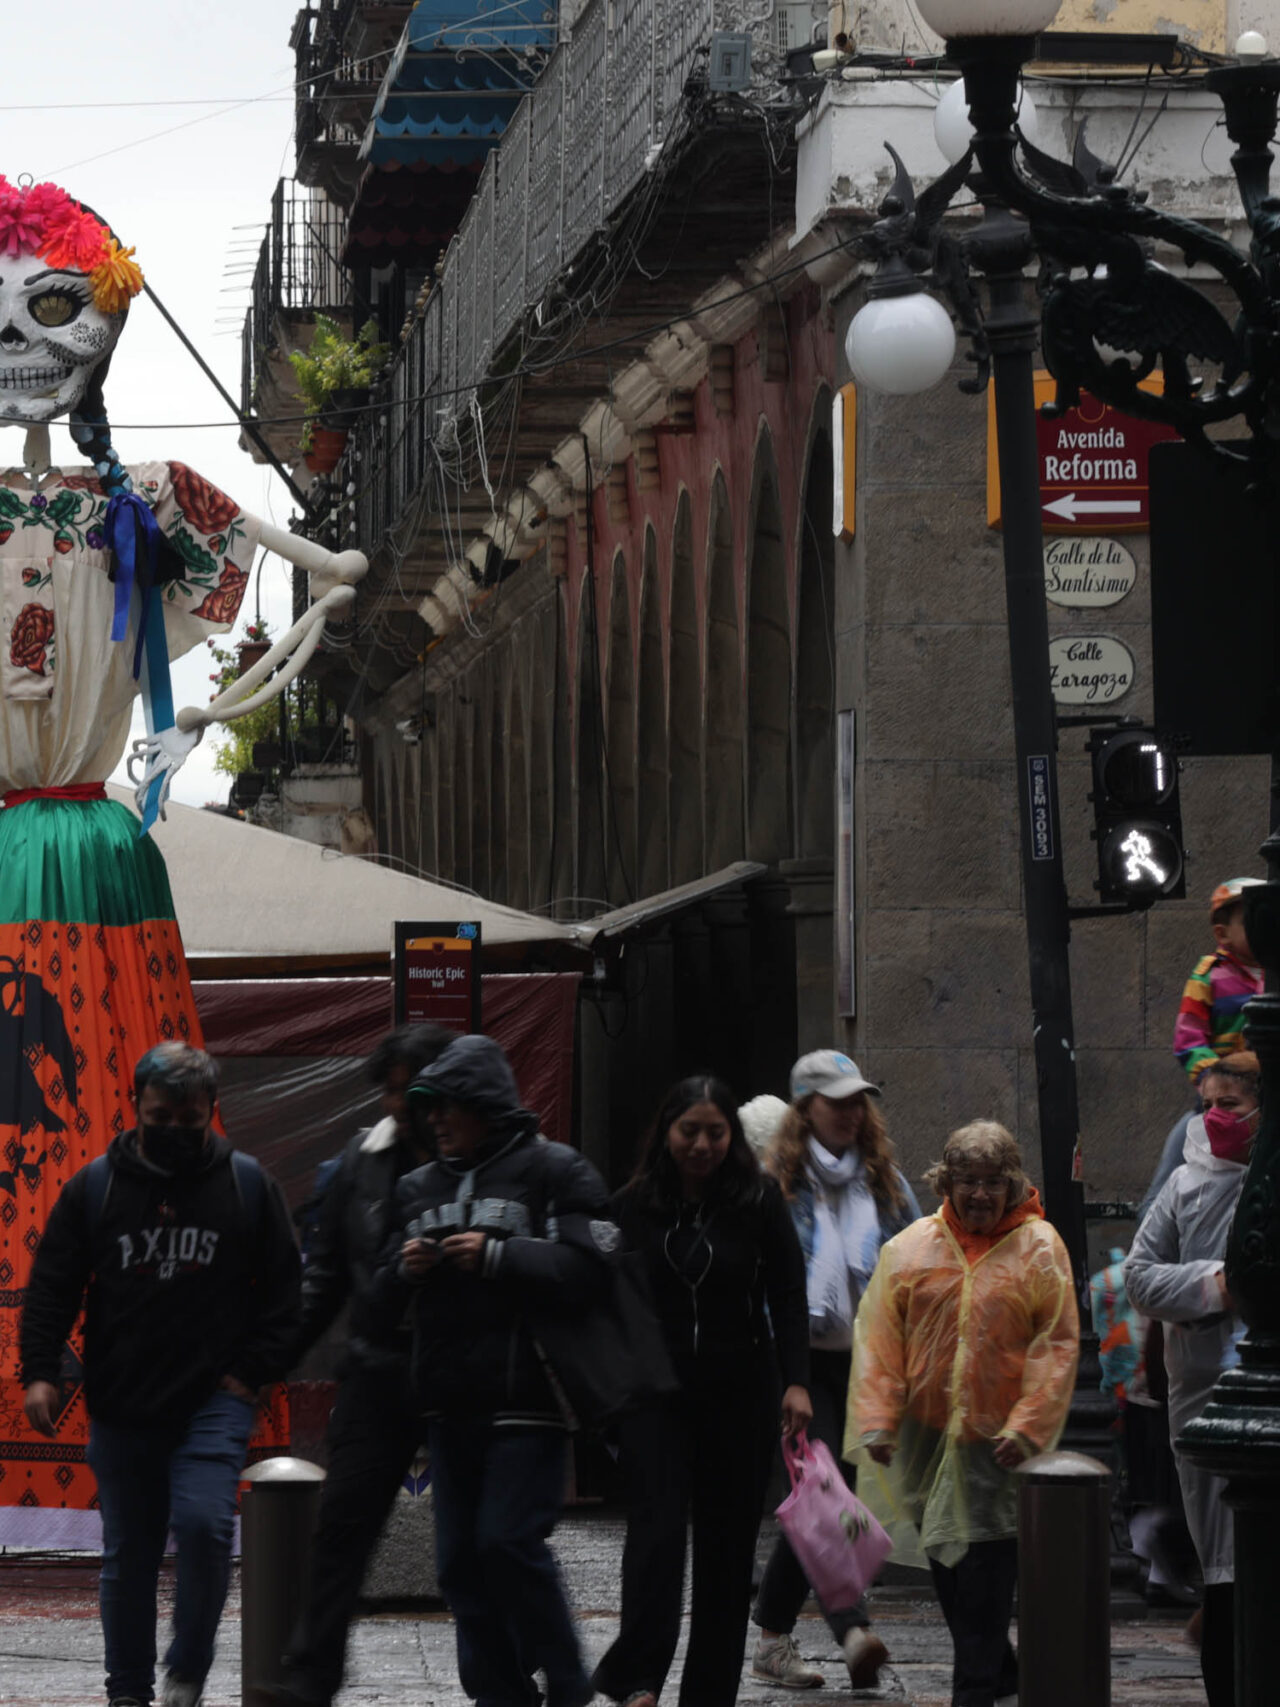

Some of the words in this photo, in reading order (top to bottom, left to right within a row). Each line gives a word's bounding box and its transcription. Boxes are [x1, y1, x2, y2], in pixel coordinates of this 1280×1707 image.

[1057, 427, 1125, 449] Avenida
[1045, 453, 1138, 480] Reforma
[1045, 541, 1086, 566] Calle
[1088, 544, 1106, 565] de
[1107, 544, 1123, 565] la
[1061, 641, 1103, 662] Calle
[1049, 665, 1128, 699] Zaragoza
[409, 967, 444, 979] Historic
[446, 967, 465, 981] Epic
